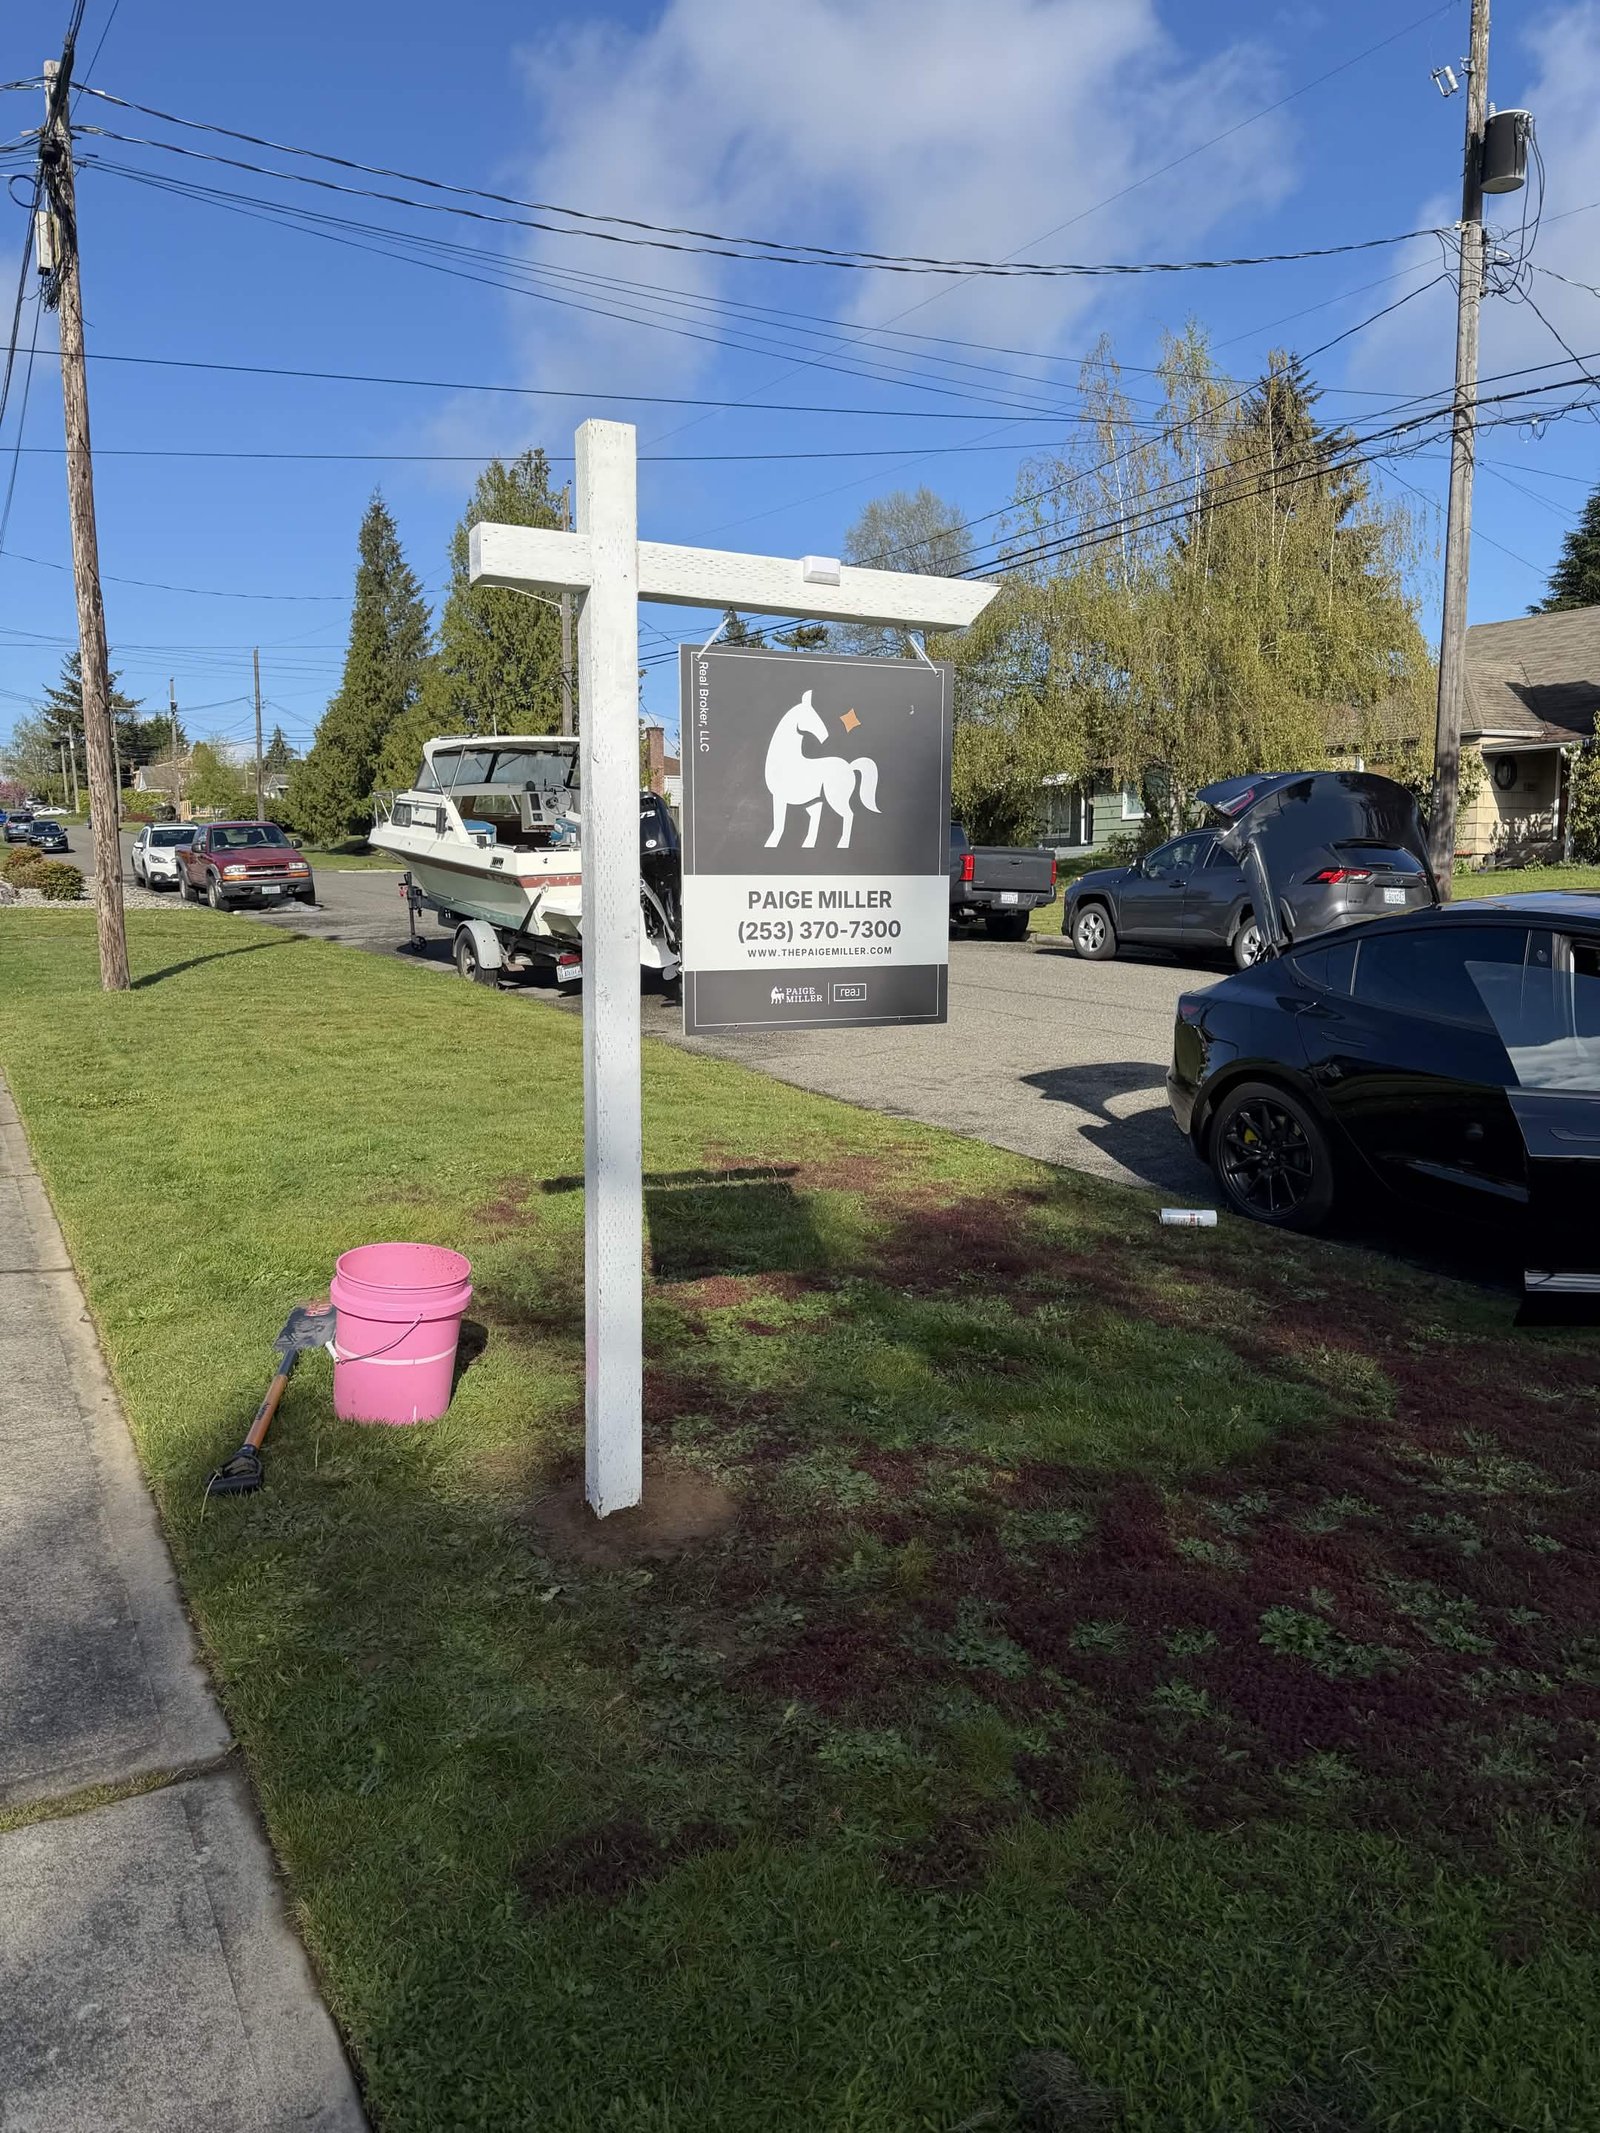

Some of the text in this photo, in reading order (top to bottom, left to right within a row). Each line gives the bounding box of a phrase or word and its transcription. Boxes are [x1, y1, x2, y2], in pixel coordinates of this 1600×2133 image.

[698, 661, 710, 752] Real Broker, LLC
[748, 890, 892, 910] PAIGE MILLER
[738, 919, 902, 944] (253) 370-7300
[747, 946, 892, 958] WWW.THEPAIGEMILLER.COM
[785, 987, 816, 995] PAIGE
[786, 994, 823, 1003] MILLER
